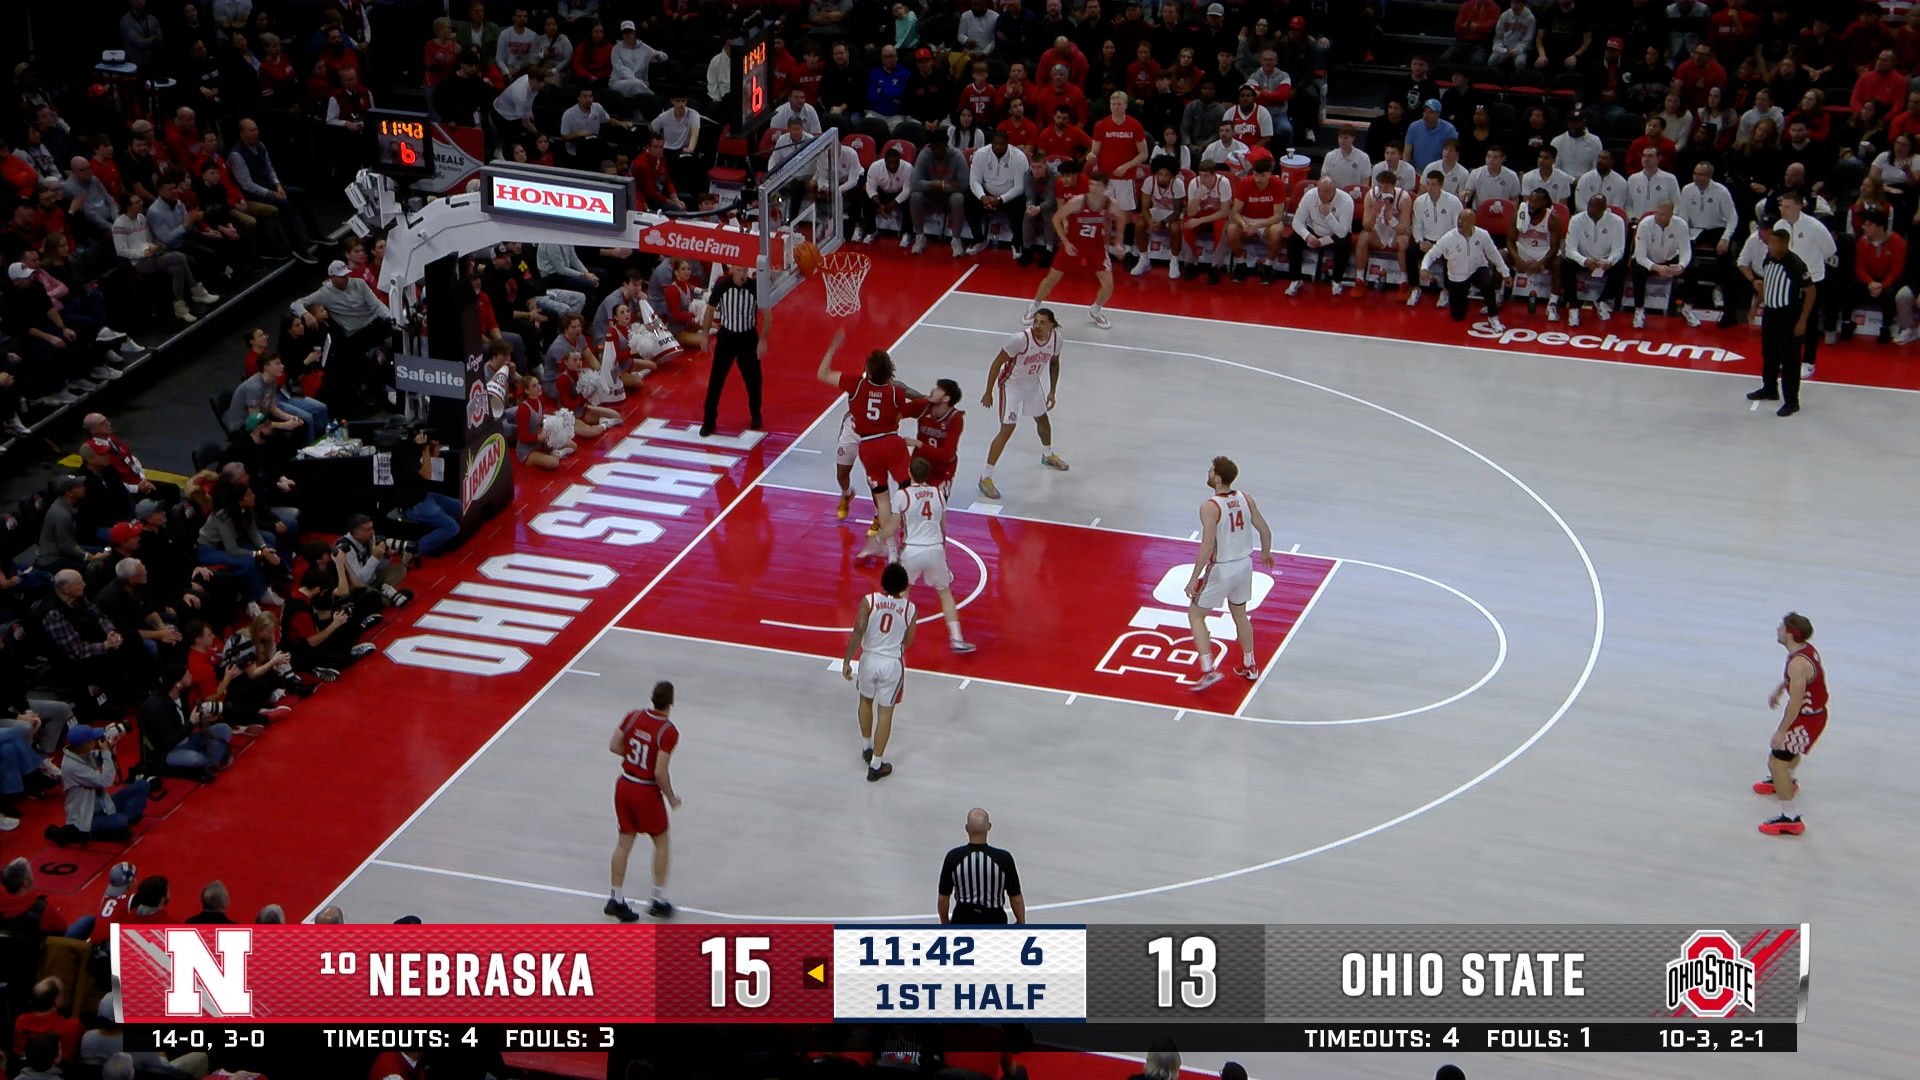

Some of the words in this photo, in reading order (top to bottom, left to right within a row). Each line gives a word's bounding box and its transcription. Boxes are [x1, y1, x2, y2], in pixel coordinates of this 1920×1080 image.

[752, 75, 764, 113] 6
[400, 142, 416, 164] 6
[496, 183, 611, 214] HONDA
[1079, 224, 1097, 238] 21
[1467, 322, 1726, 361] Spectrum
[396, 365, 465, 387] Safelite
[1028, 364, 1041, 375] 21
[866, 398, 881, 420] 5
[462, 439, 501, 516] LIBMAN
[921, 501, 933, 521] 4
[1228, 510, 1245, 532] 14
[383, 553, 619, 677] OHIO
[527, 417, 769, 547] STATE
[879, 612, 894, 633] 0
[627, 737, 649, 770] 31
[101, 899, 118, 918] 6
